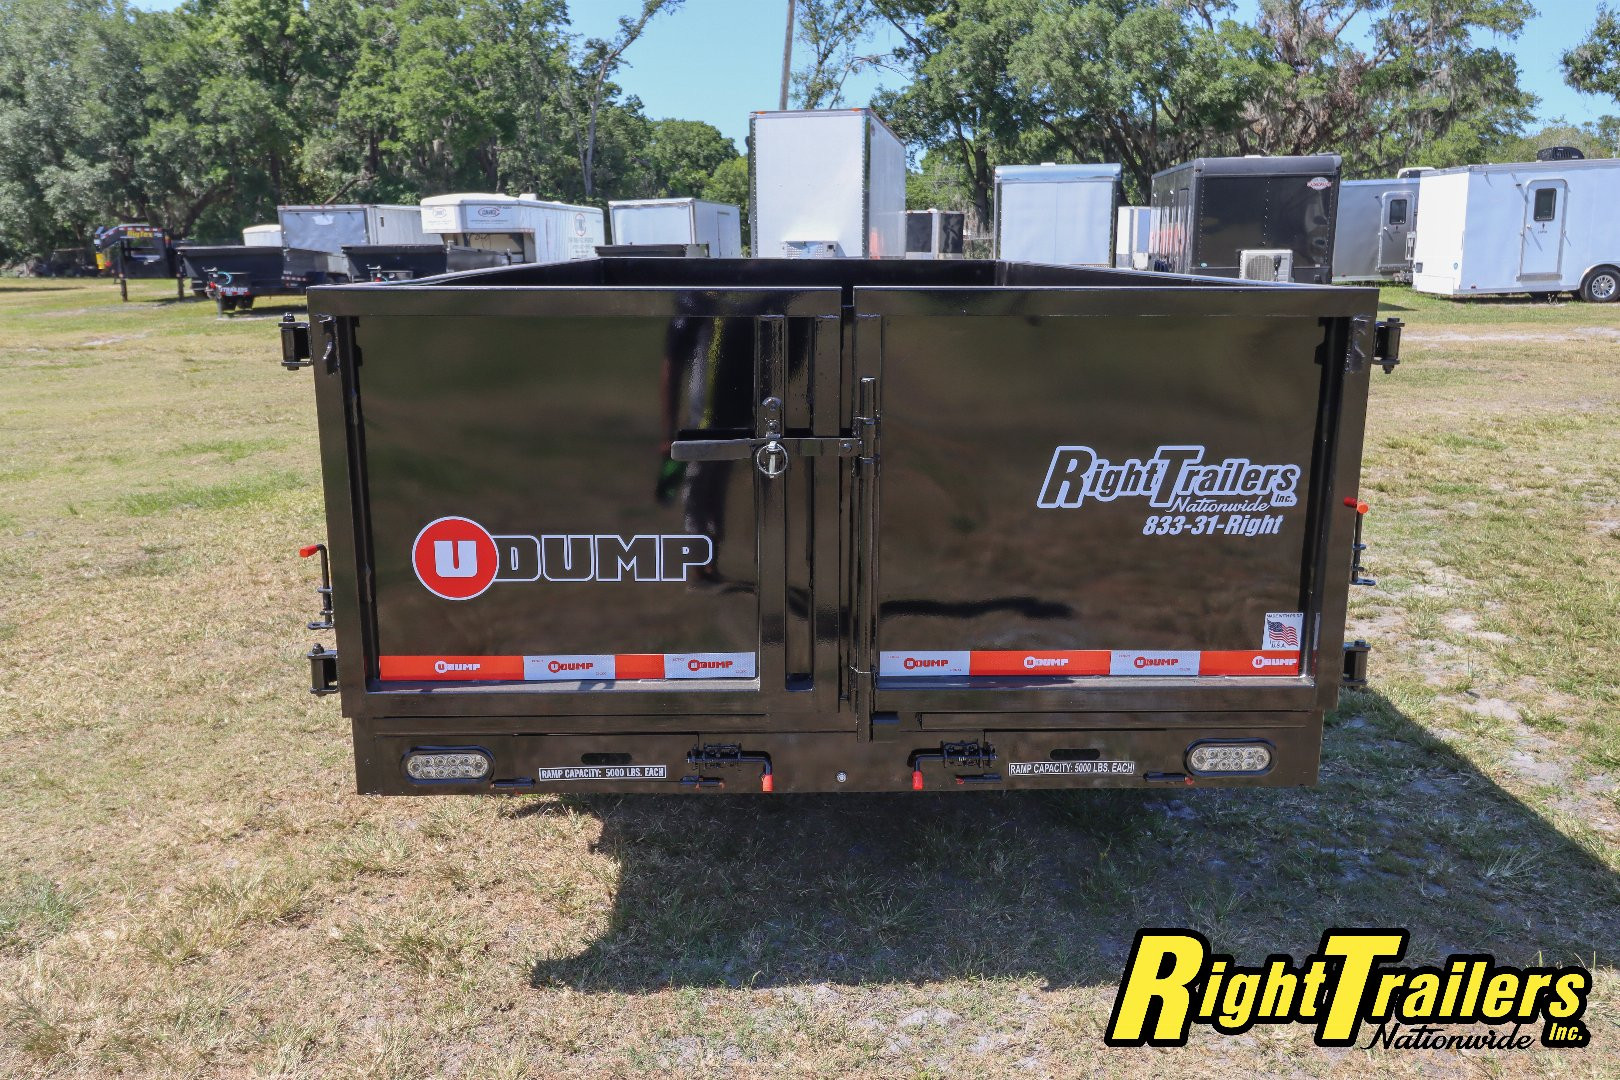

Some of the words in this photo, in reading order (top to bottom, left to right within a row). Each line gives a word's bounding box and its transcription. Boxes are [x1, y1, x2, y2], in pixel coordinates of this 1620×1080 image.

[1166, 495, 1272, 513] Nationwide
[1273, 492, 1295, 504] Inc.
[1142, 514, 1284, 537] 833-31-Right
[541, 769, 563, 779] RAMP
[564, 768, 602, 778] CAPACITY:
[605, 767, 625, 777] 5000
[626, 767, 643, 777] LBS.
[644, 767, 664, 777] EACH
[1010, 764, 1032, 774] RAMP
[1033, 763, 1073, 773] CAPACITY:
[1074, 763, 1091, 773] 5000
[1092, 763, 1110, 773] LBS.
[1111, 762, 1134, 773] EACH
